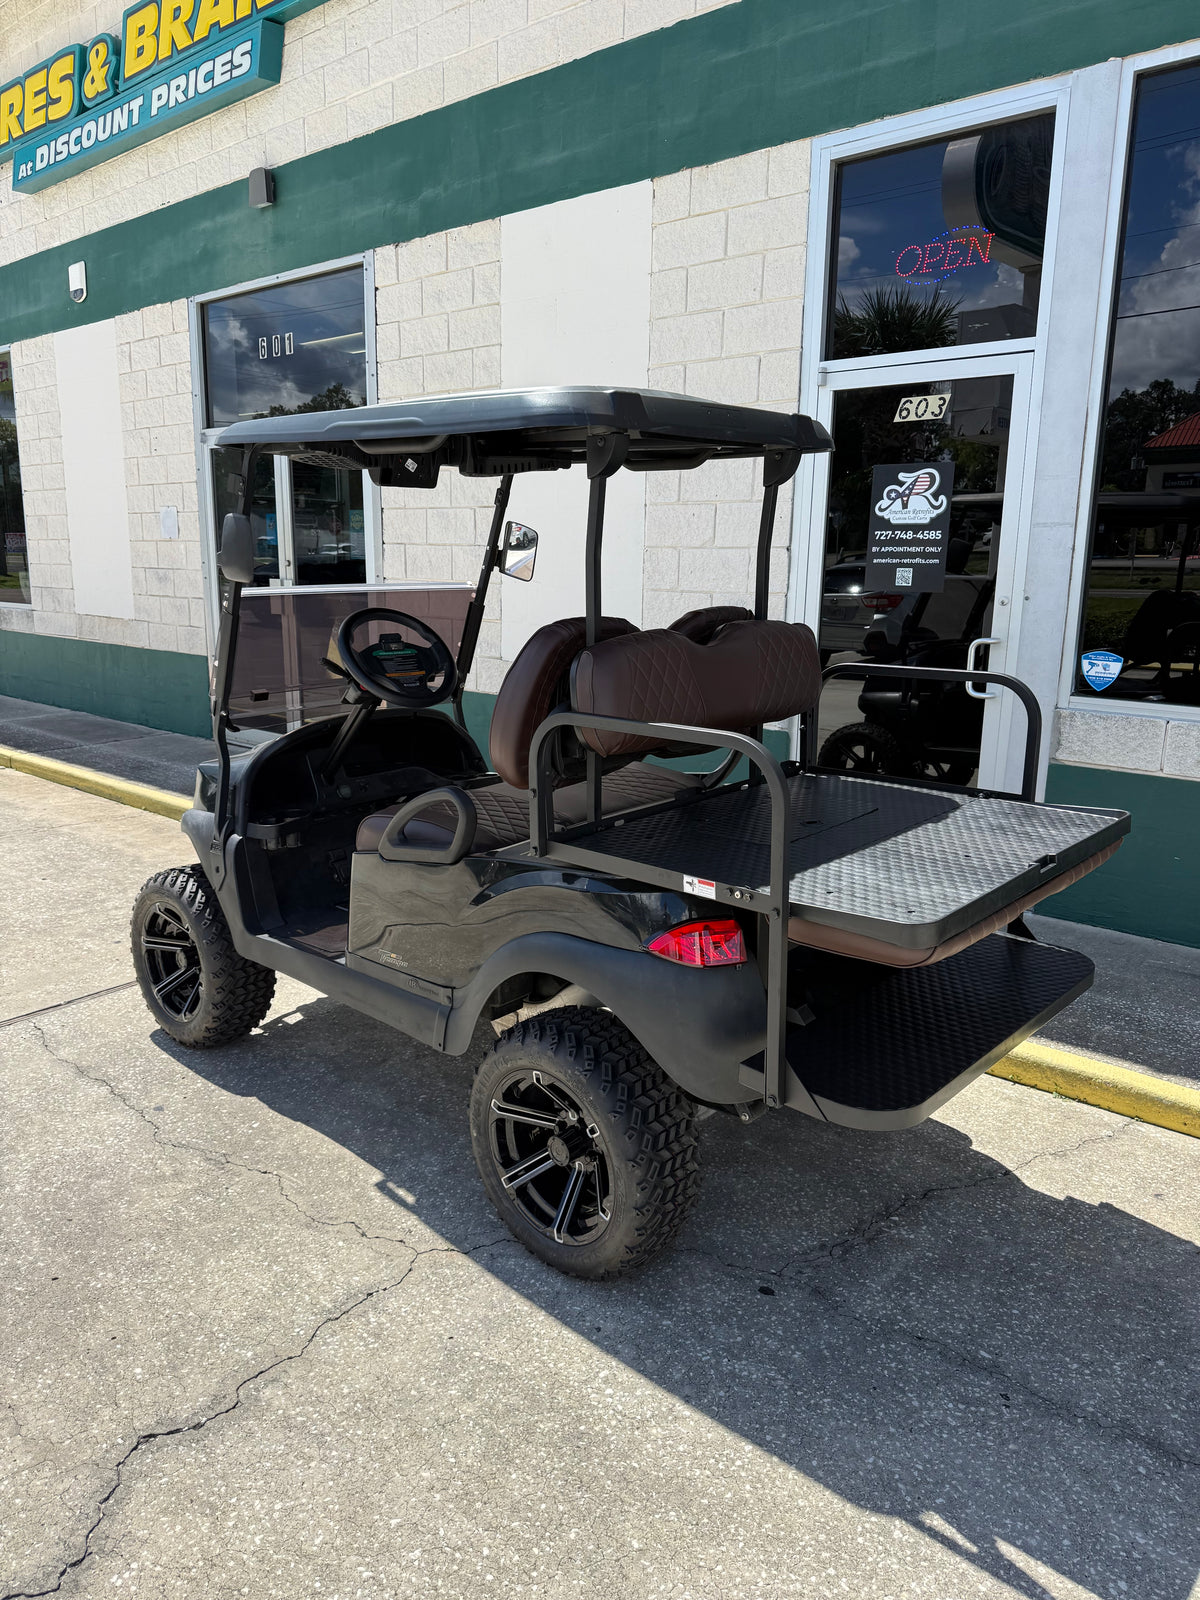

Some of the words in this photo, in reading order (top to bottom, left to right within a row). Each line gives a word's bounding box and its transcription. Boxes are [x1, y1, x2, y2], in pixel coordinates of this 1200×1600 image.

[0, 54, 74, 145] RES
[84, 42, 110, 99] &
[18, 160, 33, 181] At
[35, 95, 144, 172] DISCOUNT
[150, 39, 252, 117] PRICES
[895, 232, 996, 278] OPEN
[260, 332, 294, 359] 601
[898, 396, 947, 420] 603
[886, 508, 911, 516] American
[911, 508, 935, 517] Retrofits
[874, 530, 942, 540] 727-748-4585
